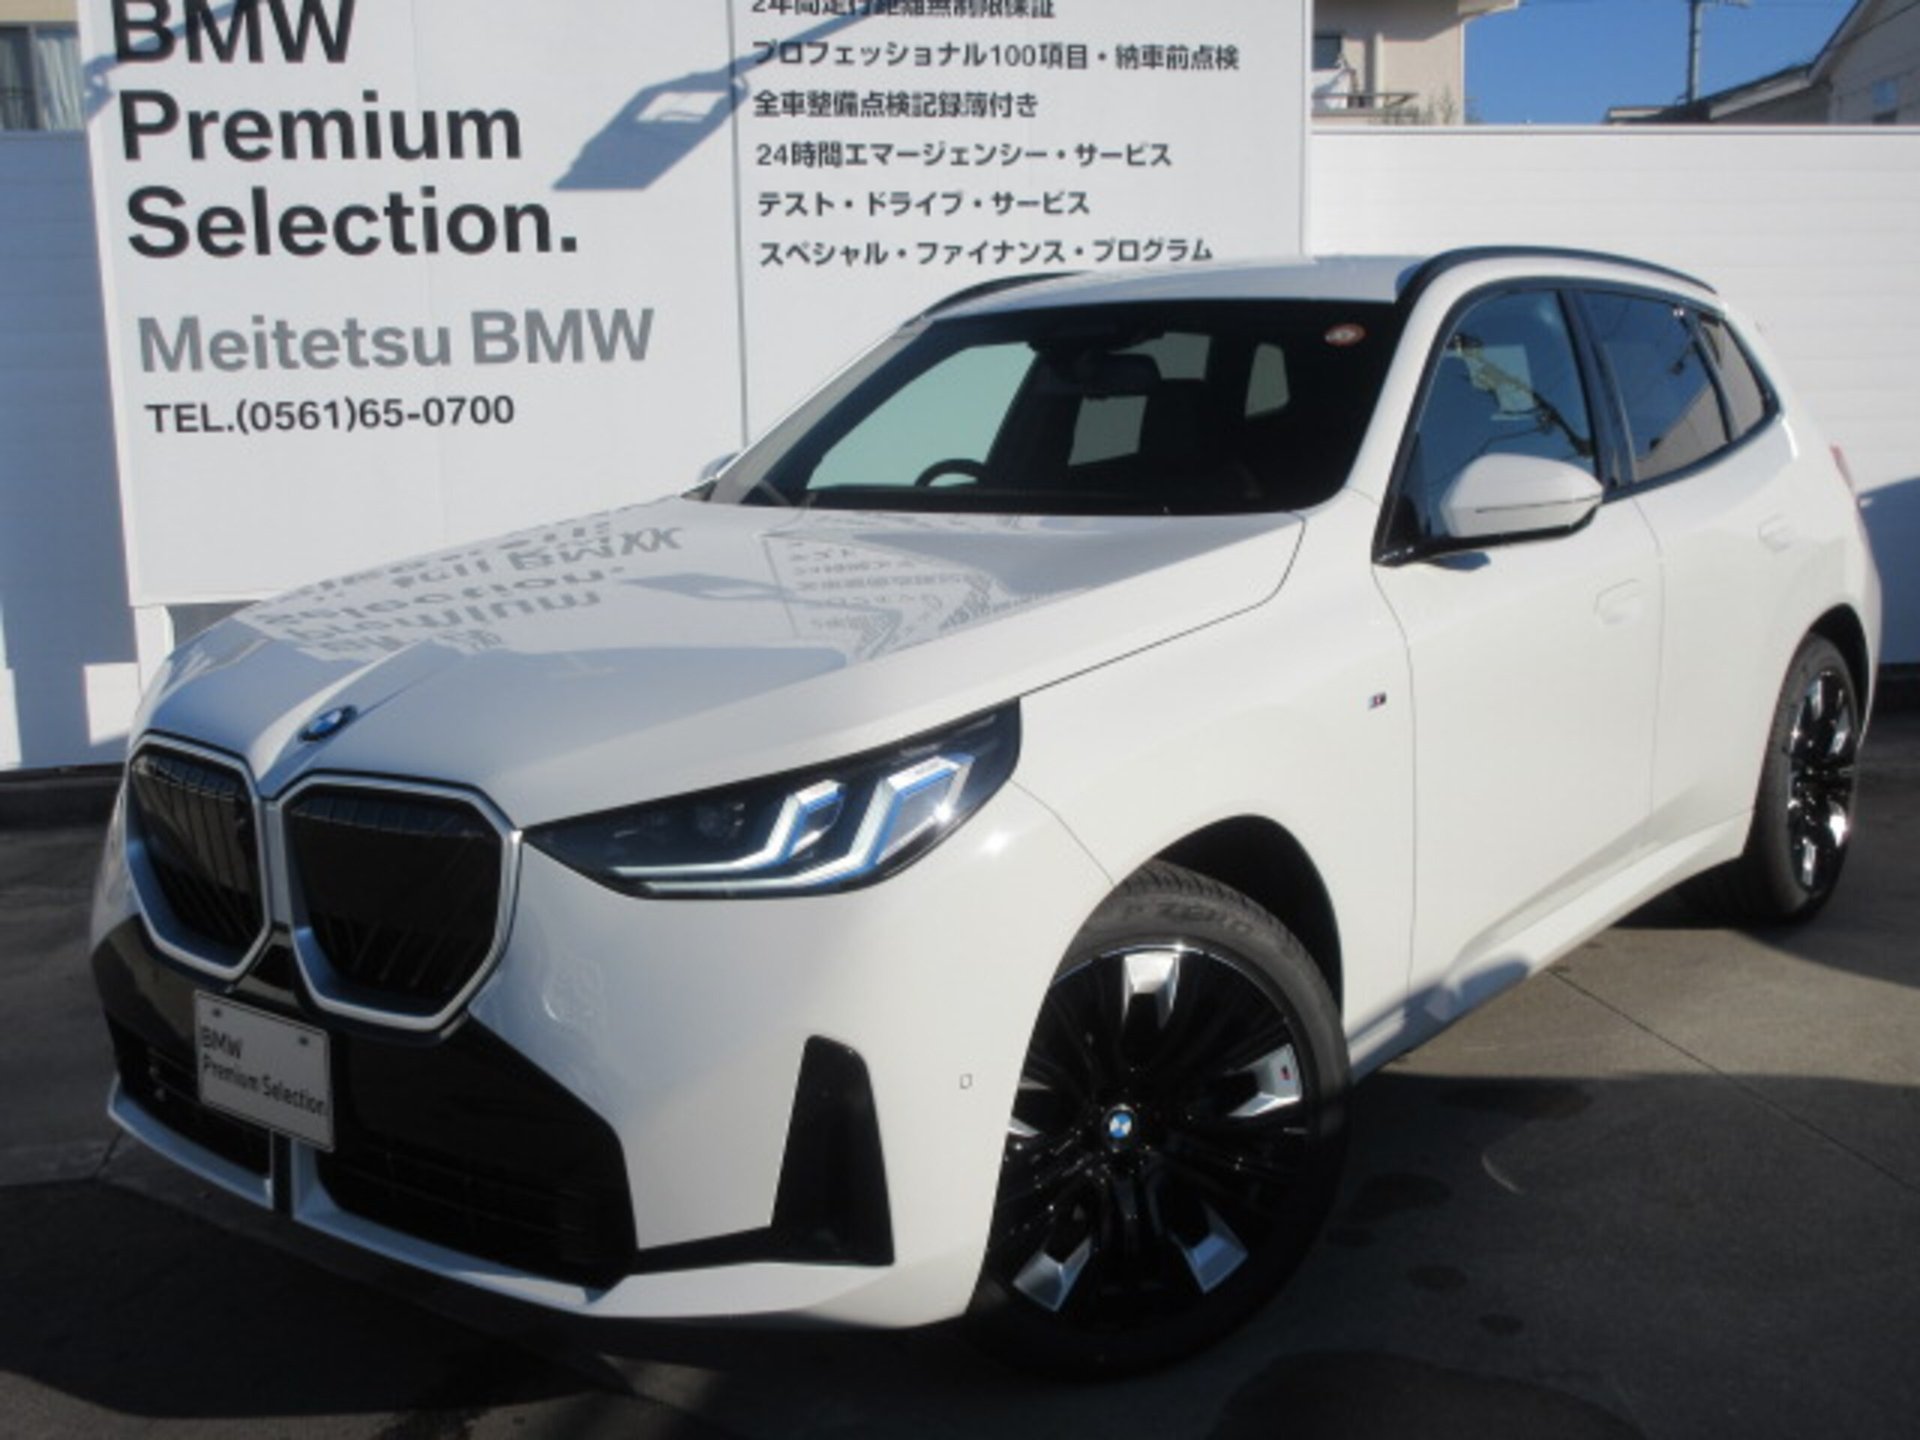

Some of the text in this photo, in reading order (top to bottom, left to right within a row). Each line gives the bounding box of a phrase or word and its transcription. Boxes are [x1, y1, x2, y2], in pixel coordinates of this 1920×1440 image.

[111, 0, 356, 64] BMW
[119, 90, 521, 161] Premium
[757, 140, 1172, 168] 24時間エマージェンシー・サービス
[127, 186, 578, 258] Selection.
[758, 191, 1090, 217] テスト・ドライブ・サービス
[760, 239, 1213, 267] スペシャル・ファイナンス・プログラム
[138, 308, 655, 373] Meitetsu BMW
[145, 395, 515, 434] TEL.(0561)65-0700
[202, 1025, 243, 1059] BMW
